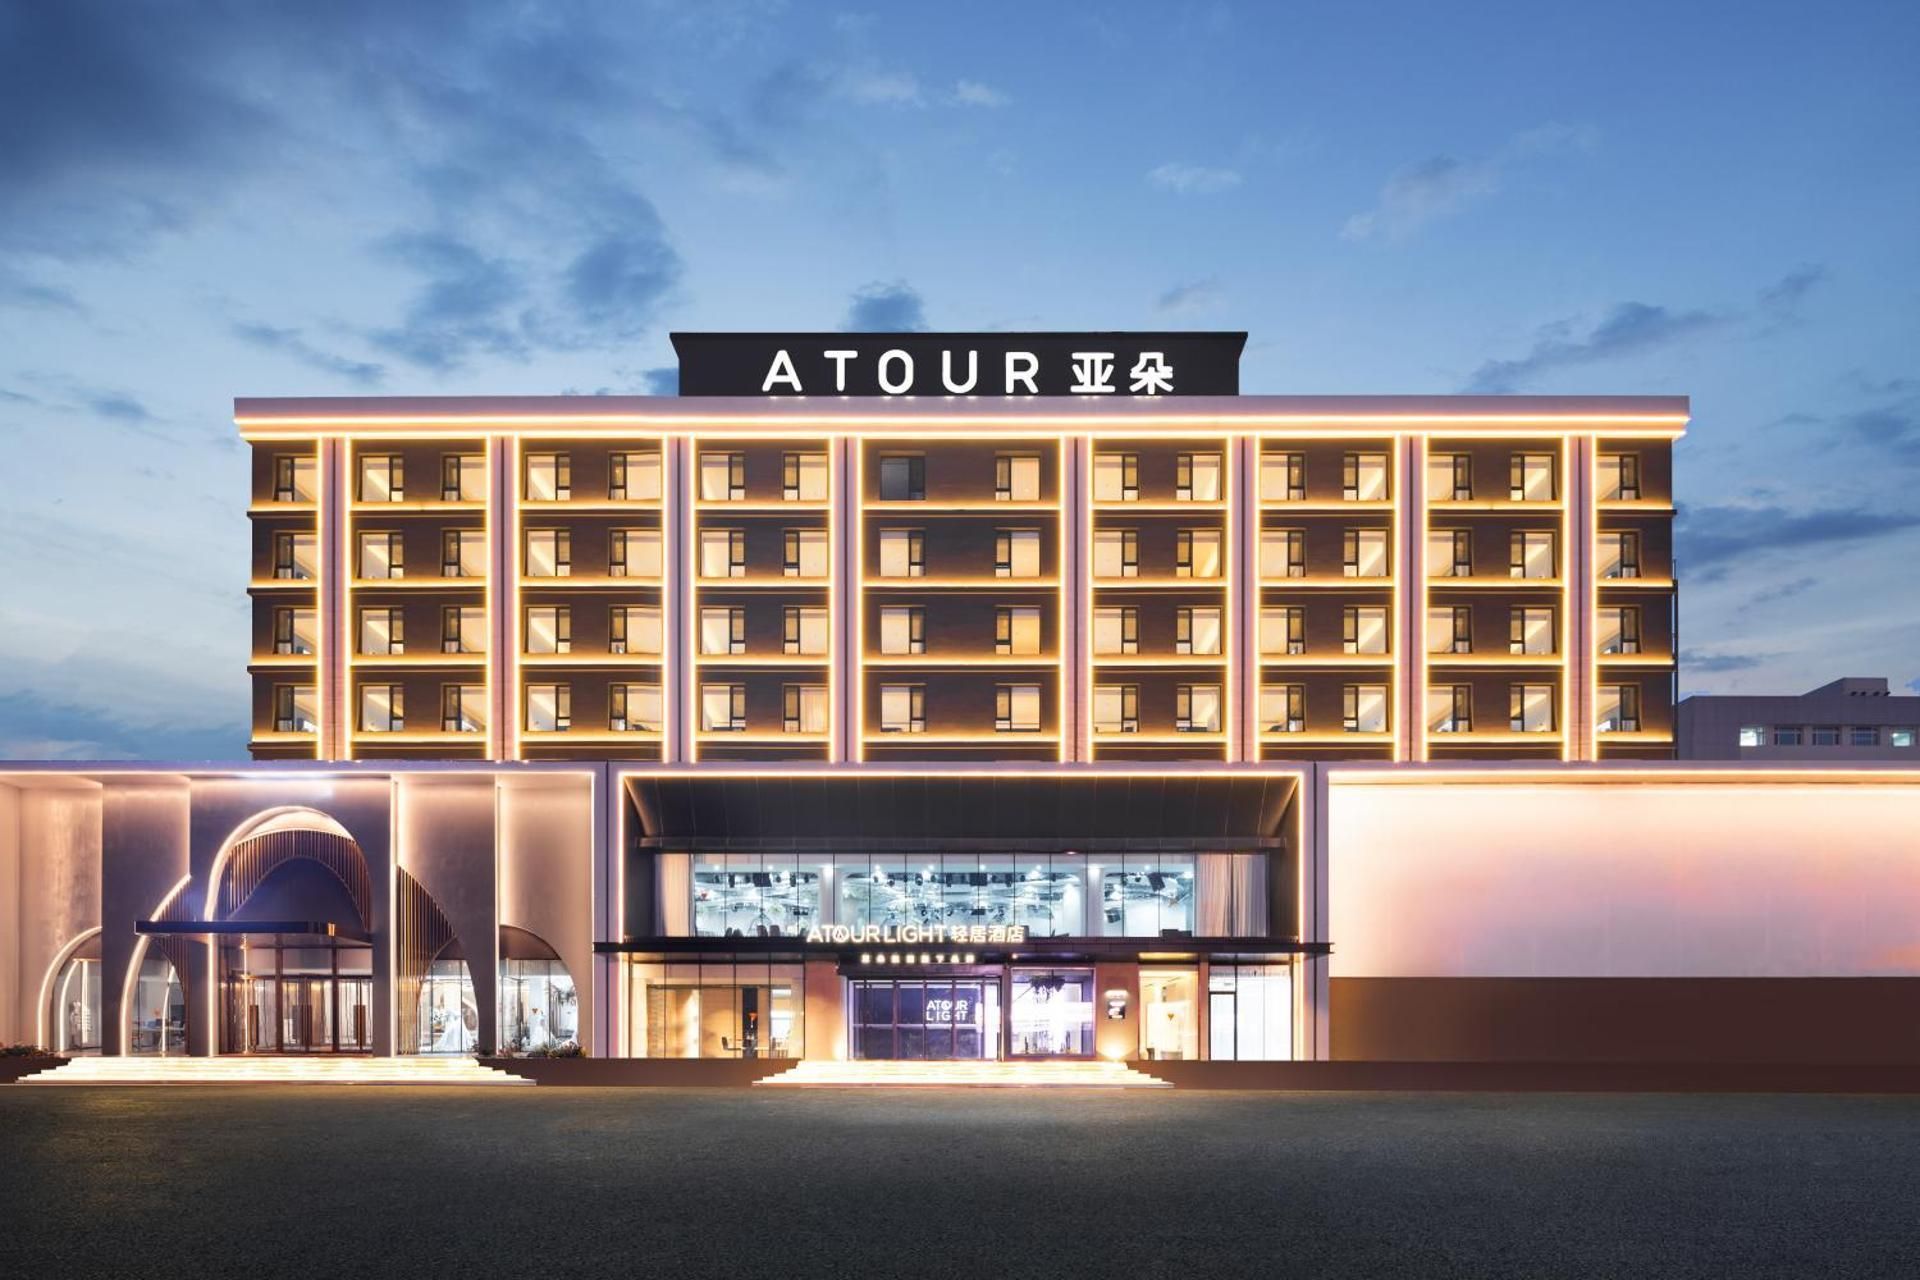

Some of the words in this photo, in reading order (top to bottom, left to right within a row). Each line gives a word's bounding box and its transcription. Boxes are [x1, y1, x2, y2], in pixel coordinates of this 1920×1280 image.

[762, 350, 1038, 393] ATOUR
[1070, 352, 1174, 393] 亚朵
[806, 925, 880, 943] ATOUR
[883, 925, 947, 943] LIGHT
[951, 925, 1025, 943] 轻居酒店
[926, 999, 969, 1011] ATOUR
